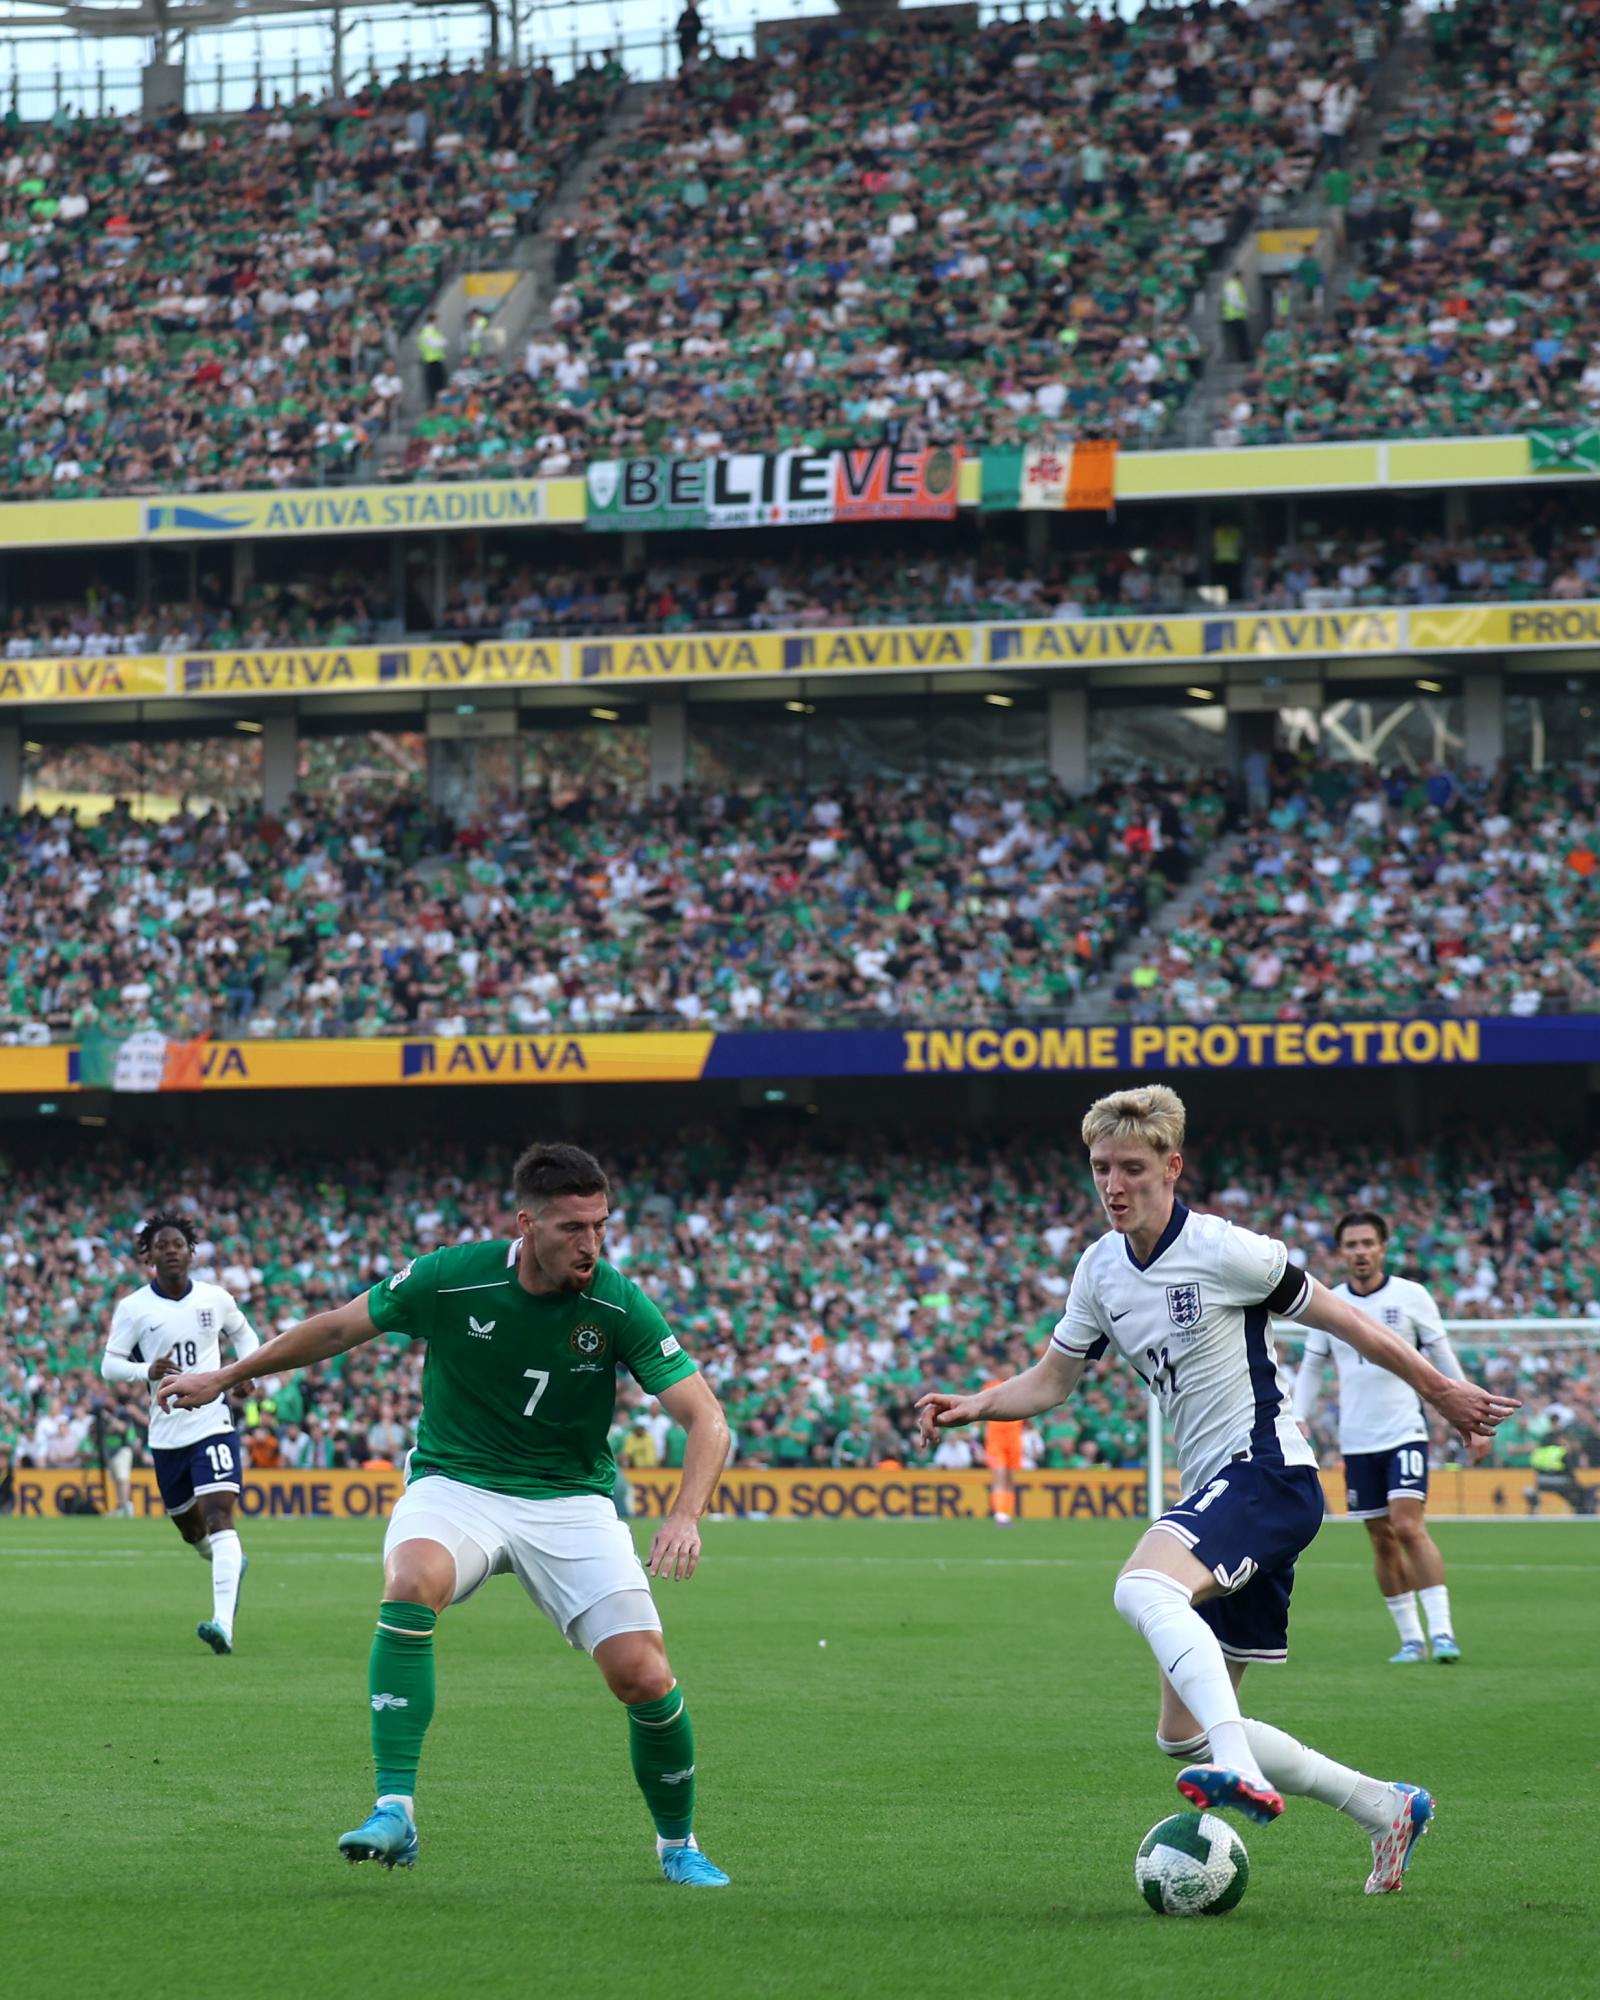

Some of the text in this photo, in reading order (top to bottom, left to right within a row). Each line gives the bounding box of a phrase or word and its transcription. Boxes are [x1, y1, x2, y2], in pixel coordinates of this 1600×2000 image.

[624, 449, 919, 506] BELIEVE
[265, 490, 540, 530] AVIVA STADIUM
[828, 631, 963, 664] AVIVA
[1036, 623, 1174, 656] AVIVA
[1249, 614, 1390, 648] AVIVA
[226, 656, 356, 687] AVIVA
[423, 647, 552, 679] AVIVA
[626, 640, 759, 672] AVIVA
[446, 1041, 588, 1073] AVIVA
[903, 1020, 1481, 1071] INCOME PROTECTION
[173, 1341, 197, 1366] 18
[523, 1368, 550, 1416] 7
[206, 1443, 235, 1472] 18
[1397, 1449, 1424, 1477] 10
[239, 1484, 333, 1516] OME
[343, 1484, 397, 1516] OF
[706, 1484, 778, 1517] ND
[792, 1482, 973, 1517] SOCCER.
[1042, 1484, 1180, 1517] TAKE
